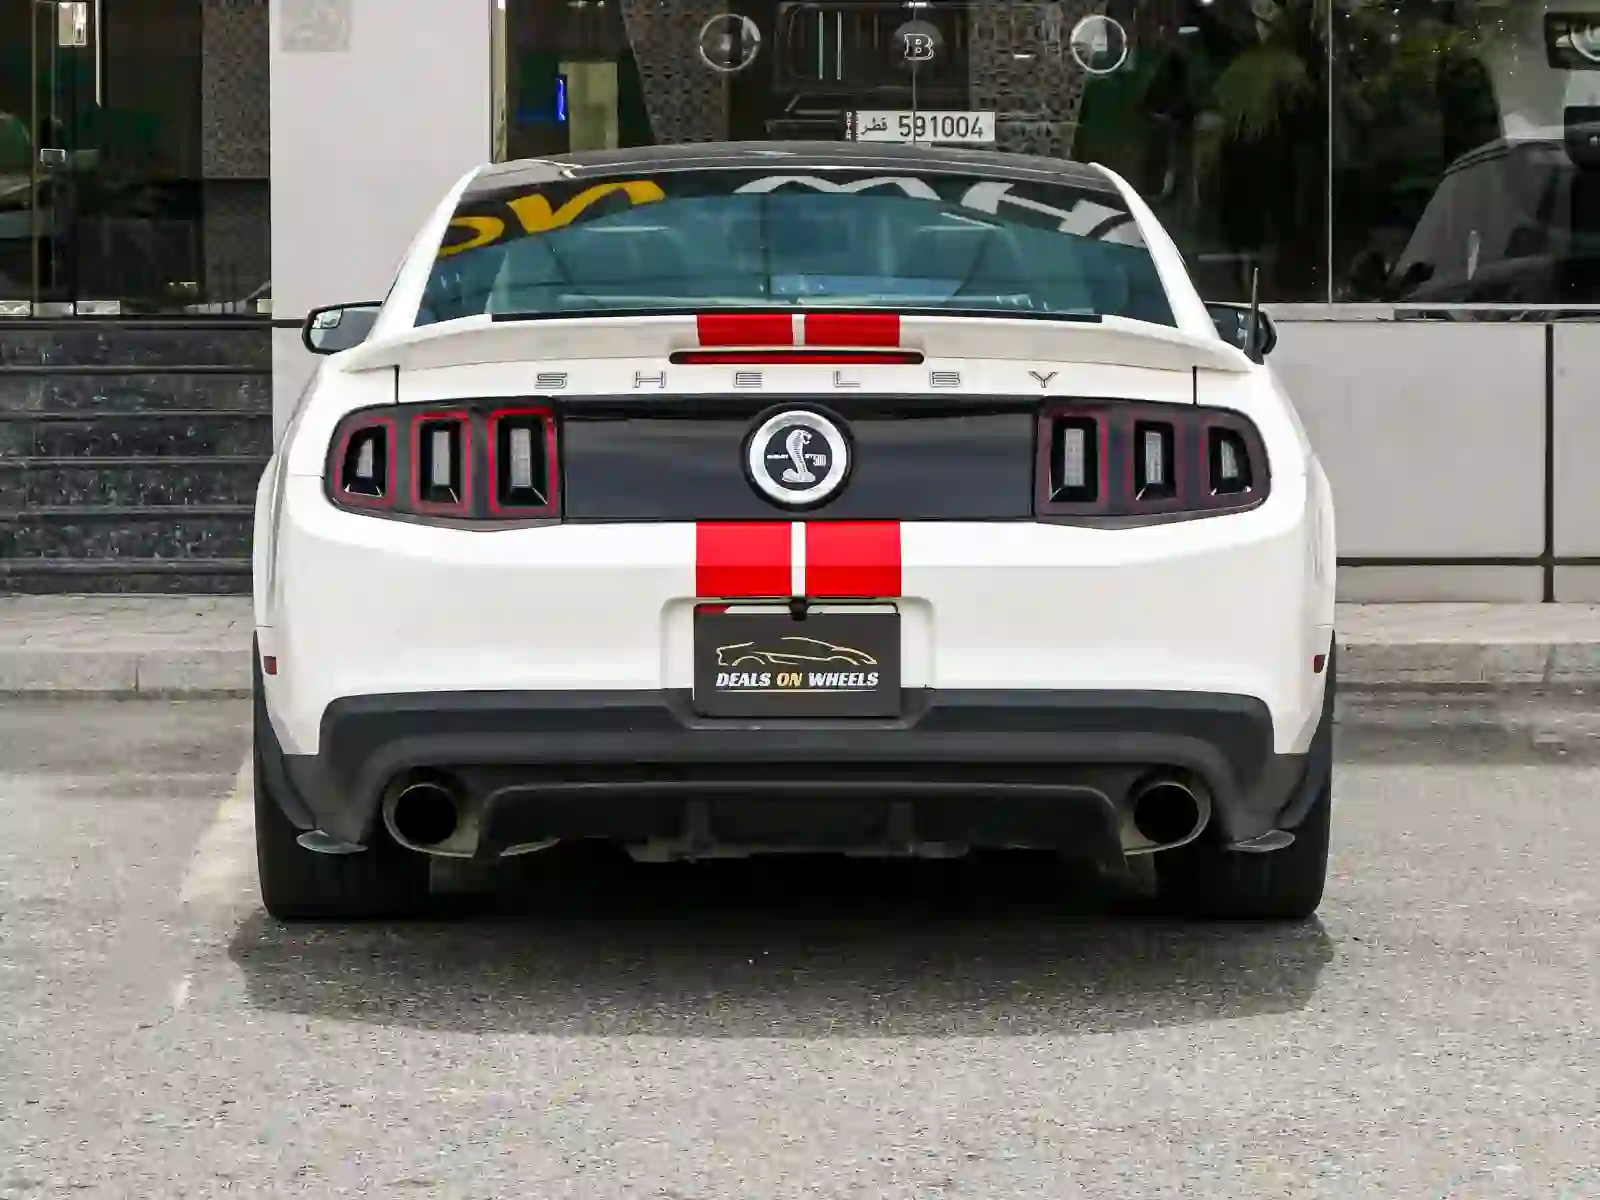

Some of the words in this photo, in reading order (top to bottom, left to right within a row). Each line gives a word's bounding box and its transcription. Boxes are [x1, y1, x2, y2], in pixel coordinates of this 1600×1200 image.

[860, 116, 889, 136] قطر
[898, 115, 984, 138] 591004
[534, 371, 1059, 390] SHELBY
[715, 672, 771, 687] DEALS
[776, 672, 803, 687] ON
[808, 672, 879, 687] WHEELS
